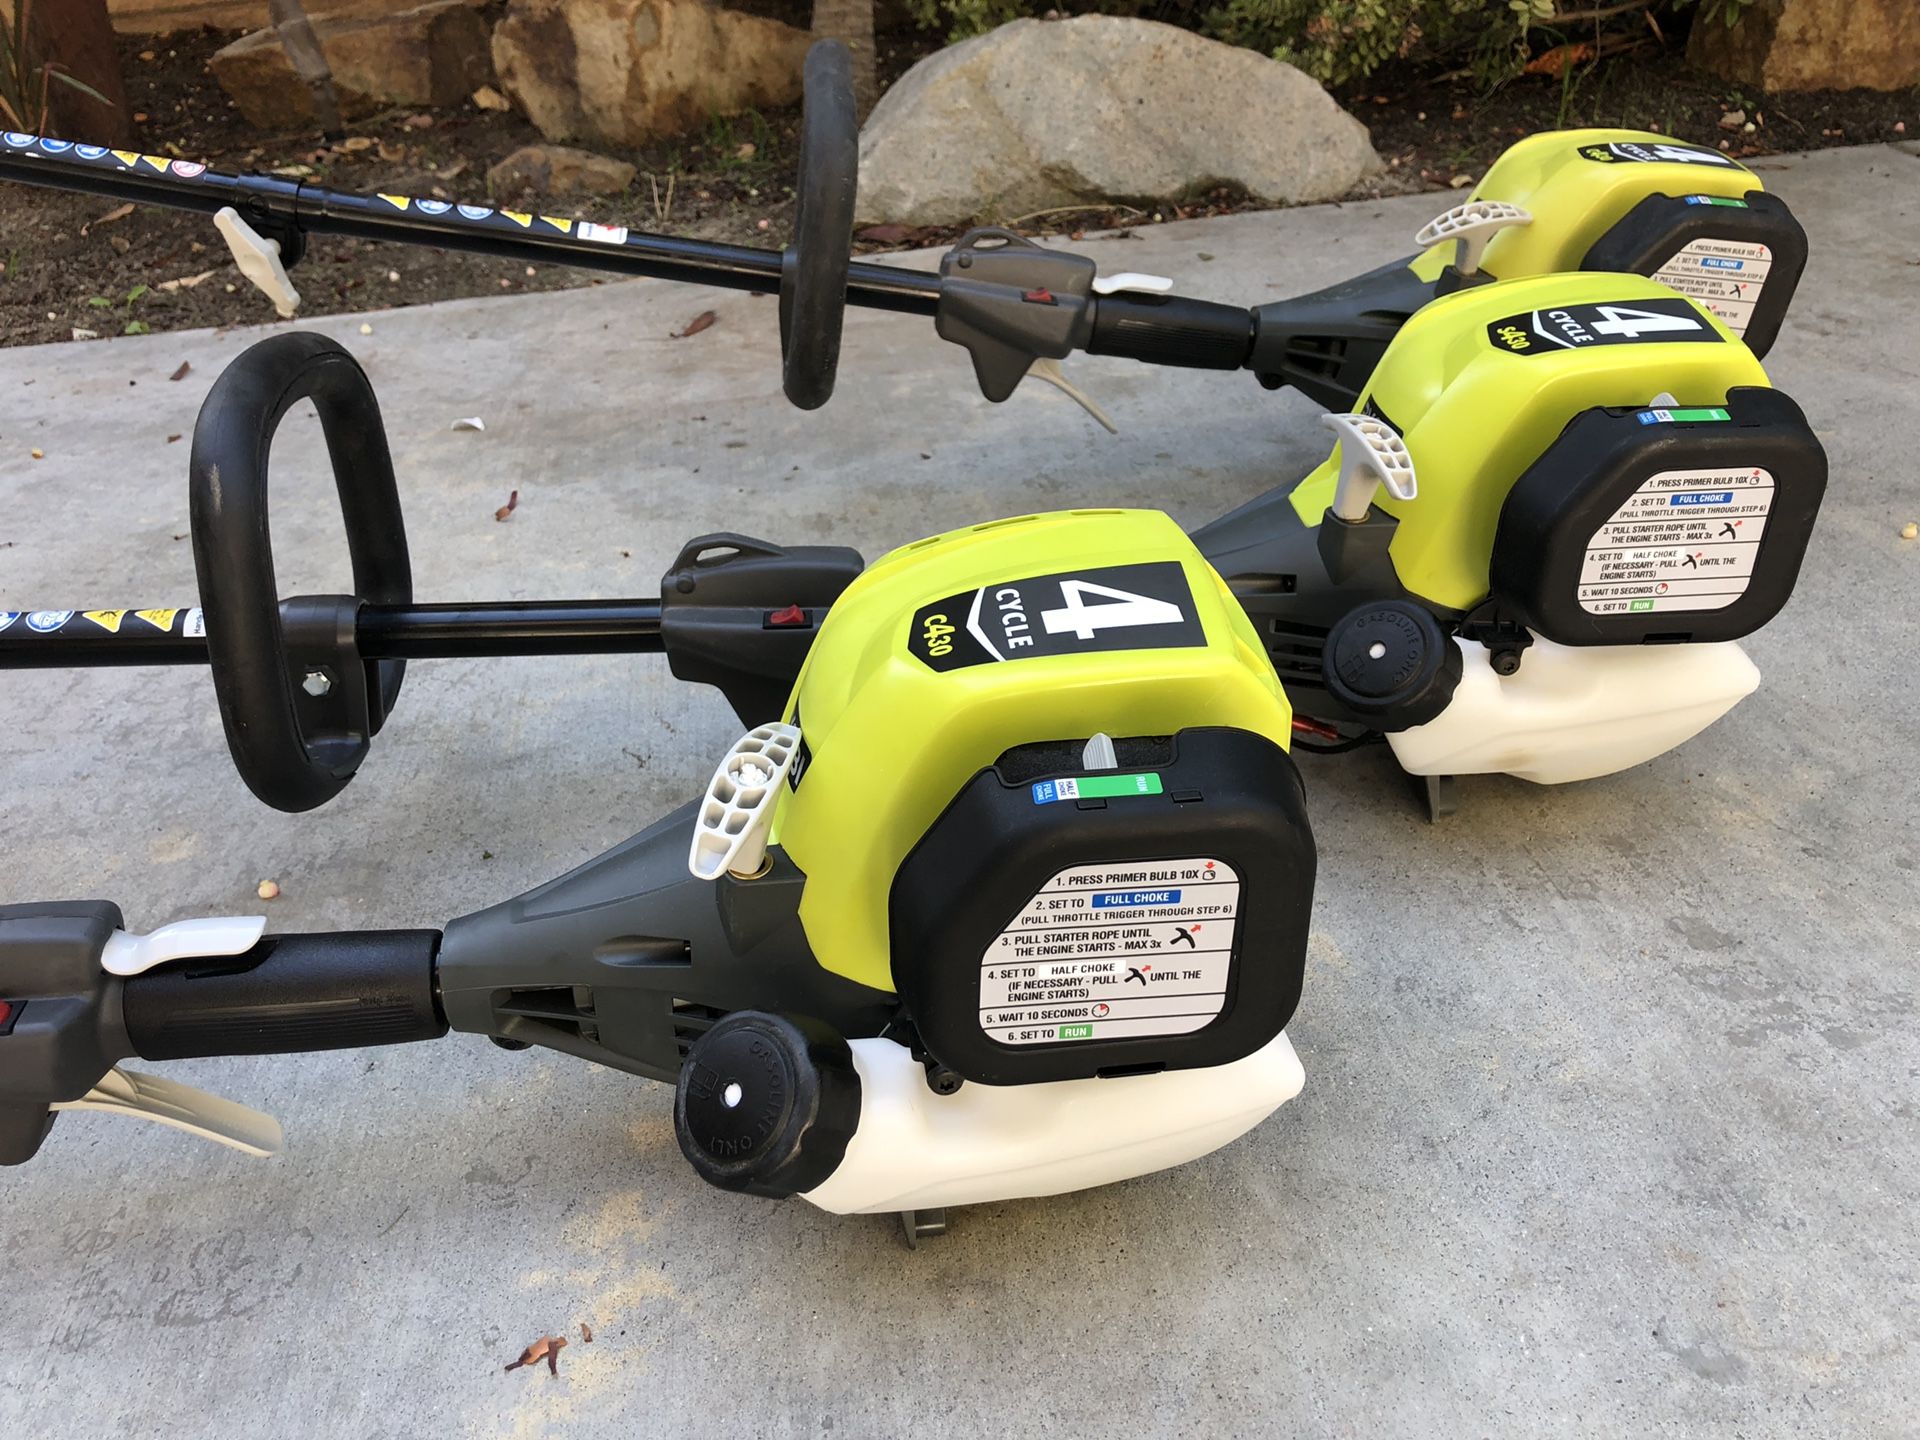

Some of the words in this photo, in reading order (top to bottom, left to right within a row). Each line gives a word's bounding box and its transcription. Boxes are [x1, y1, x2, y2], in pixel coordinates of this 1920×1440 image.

[1653, 144, 1730, 164] 4
[1548, 310, 1594, 343] CYCLE
[1590, 306, 1703, 337] 4
[1657, 479, 1681, 488] PRESS
[1683, 477, 1712, 486] PRIMER
[1713, 477, 1733, 485] BULB
[1735, 476, 1749, 484] 10X
[1641, 498, 1655, 506] SET
[1656, 497, 1666, 505] TO
[1679, 495, 1697, 503] FULL
[1699, 494, 1725, 502] CHOKE
[1620, 511, 1639, 519] (PULL
[1641, 509, 1674, 517] THROTTLE
[1676, 507, 1708, 515] TRIGGER
[1708, 506, 1739, 514] THROUGH
[1612, 527, 1630, 535] PULL
[1632, 525, 1664, 534] STARTER
[1665, 524, 1685, 532] ROPE
[1686, 523, 1707, 531] UNTIL
[1611, 535, 1626, 544] THE
[1626, 535, 1652, 543] ENGINE
[1653, 533, 1680, 542] STARTS
[1598, 553, 1611, 561] SET
[1613, 552, 1623, 560] TO
[1633, 551, 1652, 559] HALF
[1653, 550, 1678, 558] CHOKE
[1601, 563, 1611, 572] (IF
[1612, 561, 1654, 570] NECESSARY
[1660, 560, 1677, 568] PULL
[1700, 558, 1720, 566] UNTIL
[1722, 557, 1736, 565] THE
[1600, 572, 1625, 580] ENGINE
[1627, 570, 1656, 579] STARTS)
[1591, 588, 1608, 596] WAIT
[1620, 586, 1653, 594] SECONDS
[1040, 579, 1185, 640] 4
[1603, 603, 1616, 611] SET
[1633, 601, 1650, 609] RUN
[995, 588, 1034, 650] CYCLE
[923, 614, 956, 657] C430
[1043, 783, 1053, 799] FULL
[1065, 780, 1076, 796] HALF
[1136, 775, 1149, 792] RUN
[1056, 877, 1065, 886] 1.
[1069, 874, 1103, 885] PRESS
[1105, 872, 1147, 883] PRIMER
[1150, 870, 1177, 881] BULB
[1180, 869, 1200, 879] 10X
[1036, 901, 1045, 910] 2.
[1049, 899, 1068, 909] SET
[1071, 898, 1084, 908] TO
[1104, 894, 1131, 904] FULL
[1134, 892, 1170, 903] CHOKE
[1021, 915, 1049, 925] (PULL
[1052, 912, 1101, 922] THROTTLE
[1104, 909, 1145, 920] TRIGGER
[1148, 907, 1194, 917] THROUGH
[1197, 905, 1220, 915] STEP
[1222, 904, 1232, 914] 6)
[1002, 937, 1011, 946] 3.
[1015, 935, 1041, 945] PULL
[1044, 931, 1089, 943] STARTER
[1092, 930, 1120, 940] ROPE
[1122, 928, 1152, 938] UNTIL
[1015, 946, 1035, 957] THE
[1037, 944, 1074, 955] ENGINE
[1077, 942, 1115, 953] STARTS
[1124, 940, 1148, 950] MAX
[1151, 939, 1162, 949] 3x
[988, 970, 997, 980] 4.
[1000, 969, 1019, 979] SET
[1022, 967, 1035, 977] TO
[1051, 965, 1078, 975] HALF
[1081, 963, 1115, 973] CHOKE
[1008, 981, 1022, 992] (IF
[1024, 977, 1084, 989] NECESSARY
[1092, 975, 1118, 985] PULL
[1150, 971, 1179, 981] UNTIL
[1182, 970, 1202, 980] THE
[1008, 990, 1045, 1002] ENGINE
[1047, 988, 1089, 999] STARTS)
[986, 1014, 995, 1023] 5.
[998, 1012, 1024, 1022] WAIT
[1027, 1011, 1038, 1021] 10
[1041, 1008, 1088, 1019] SECONDS
[1008, 1032, 1017, 1041] 6.
[1020, 1030, 1039, 1040] SET
[1041, 1029, 1054, 1038] TO
[1065, 1027, 1087, 1037] RUN
